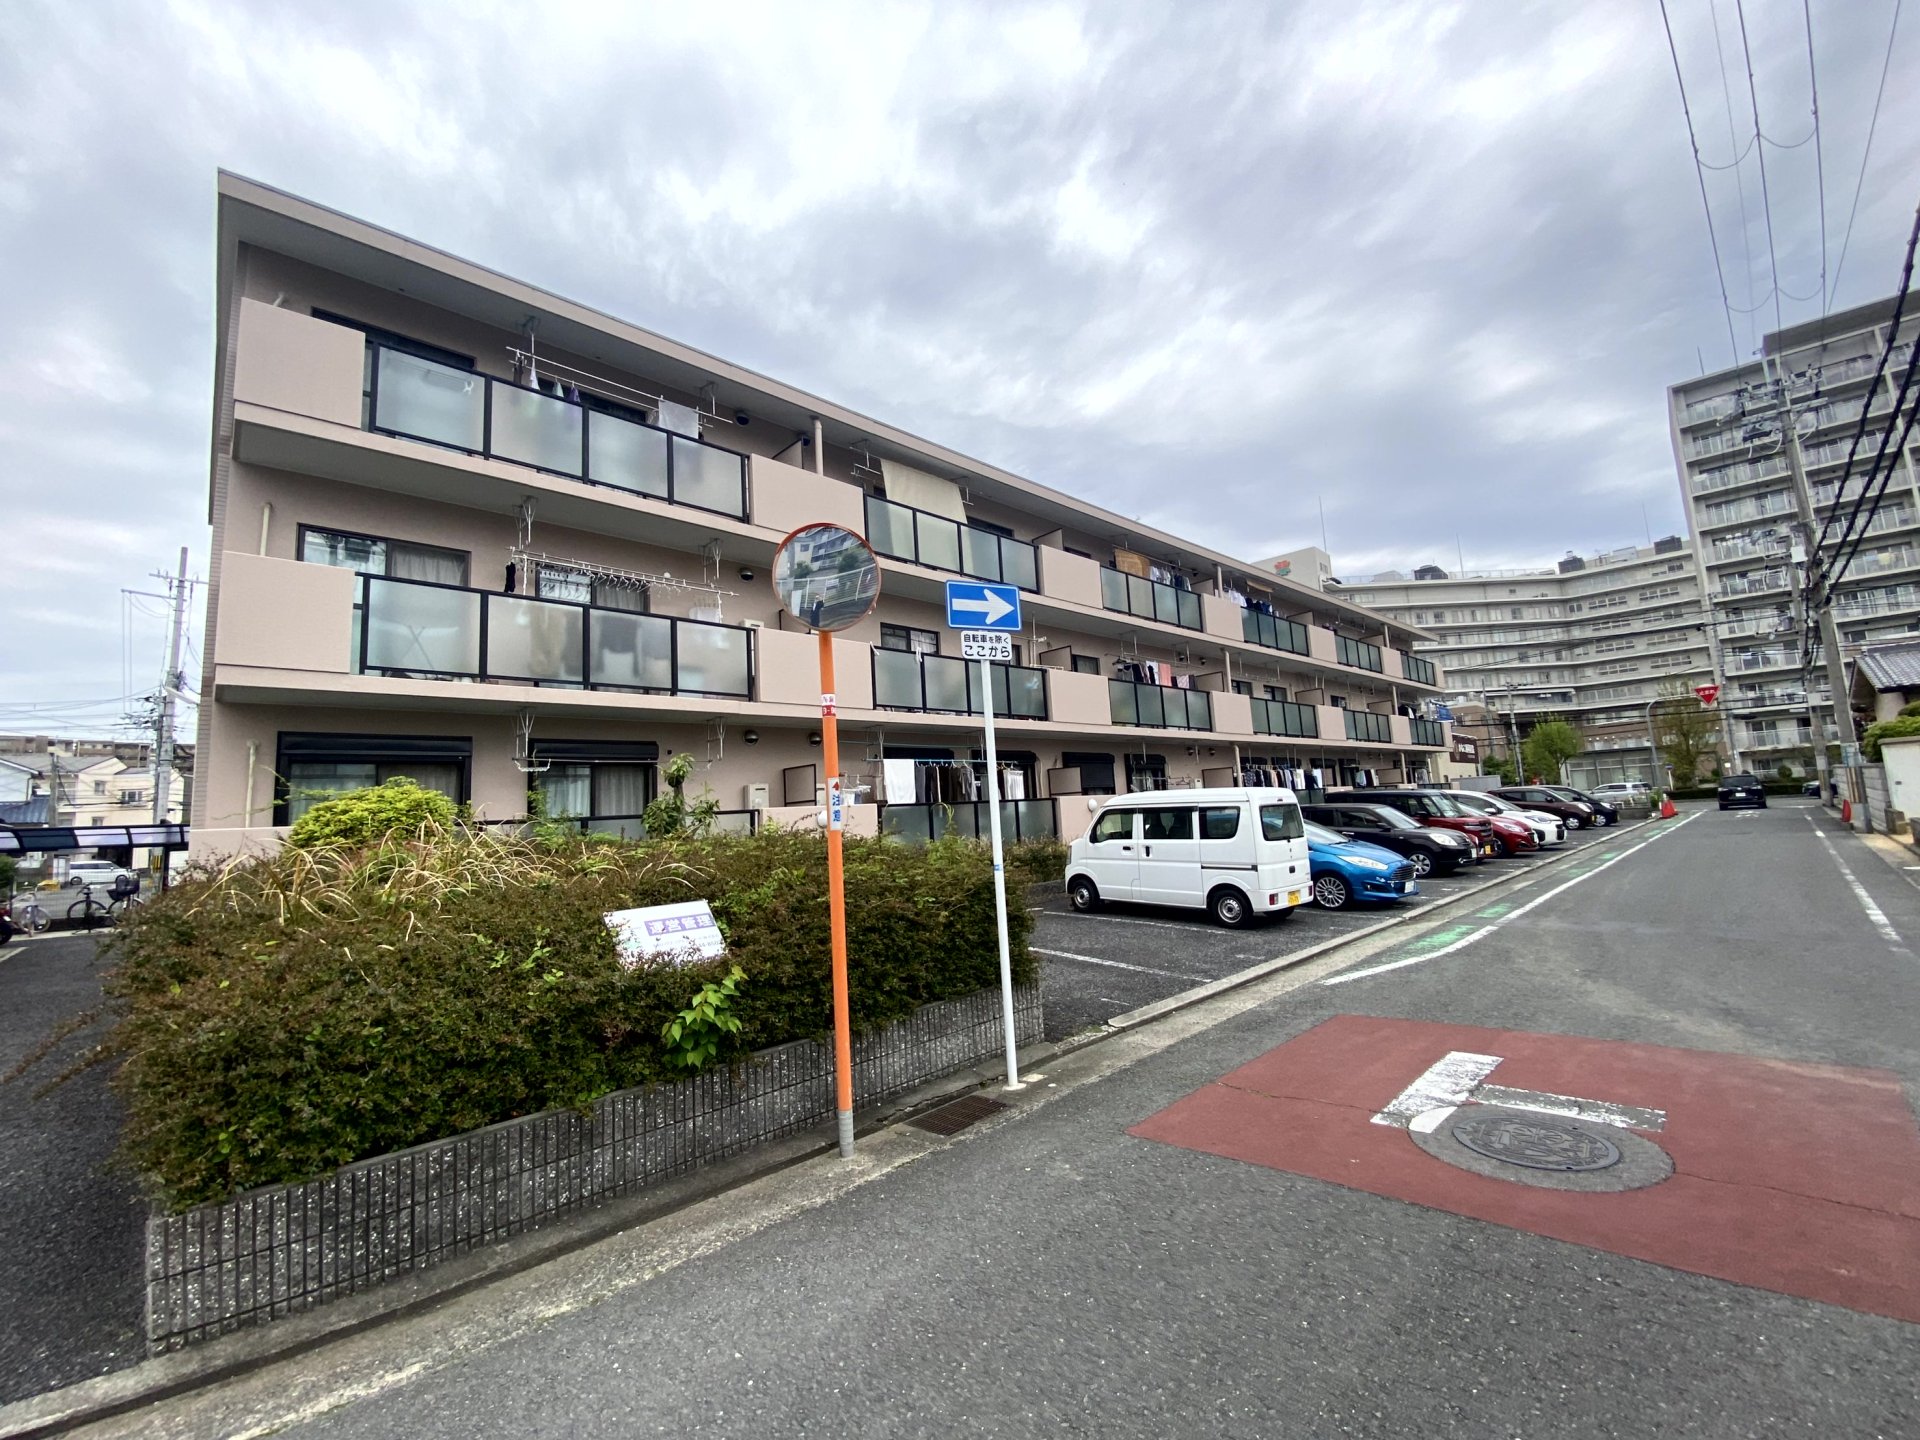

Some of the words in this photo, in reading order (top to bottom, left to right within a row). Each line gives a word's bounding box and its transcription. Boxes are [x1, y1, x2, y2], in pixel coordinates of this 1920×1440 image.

[963, 633, 1009, 644] 自転車を除く
[964, 645, 1010, 658] ここから
